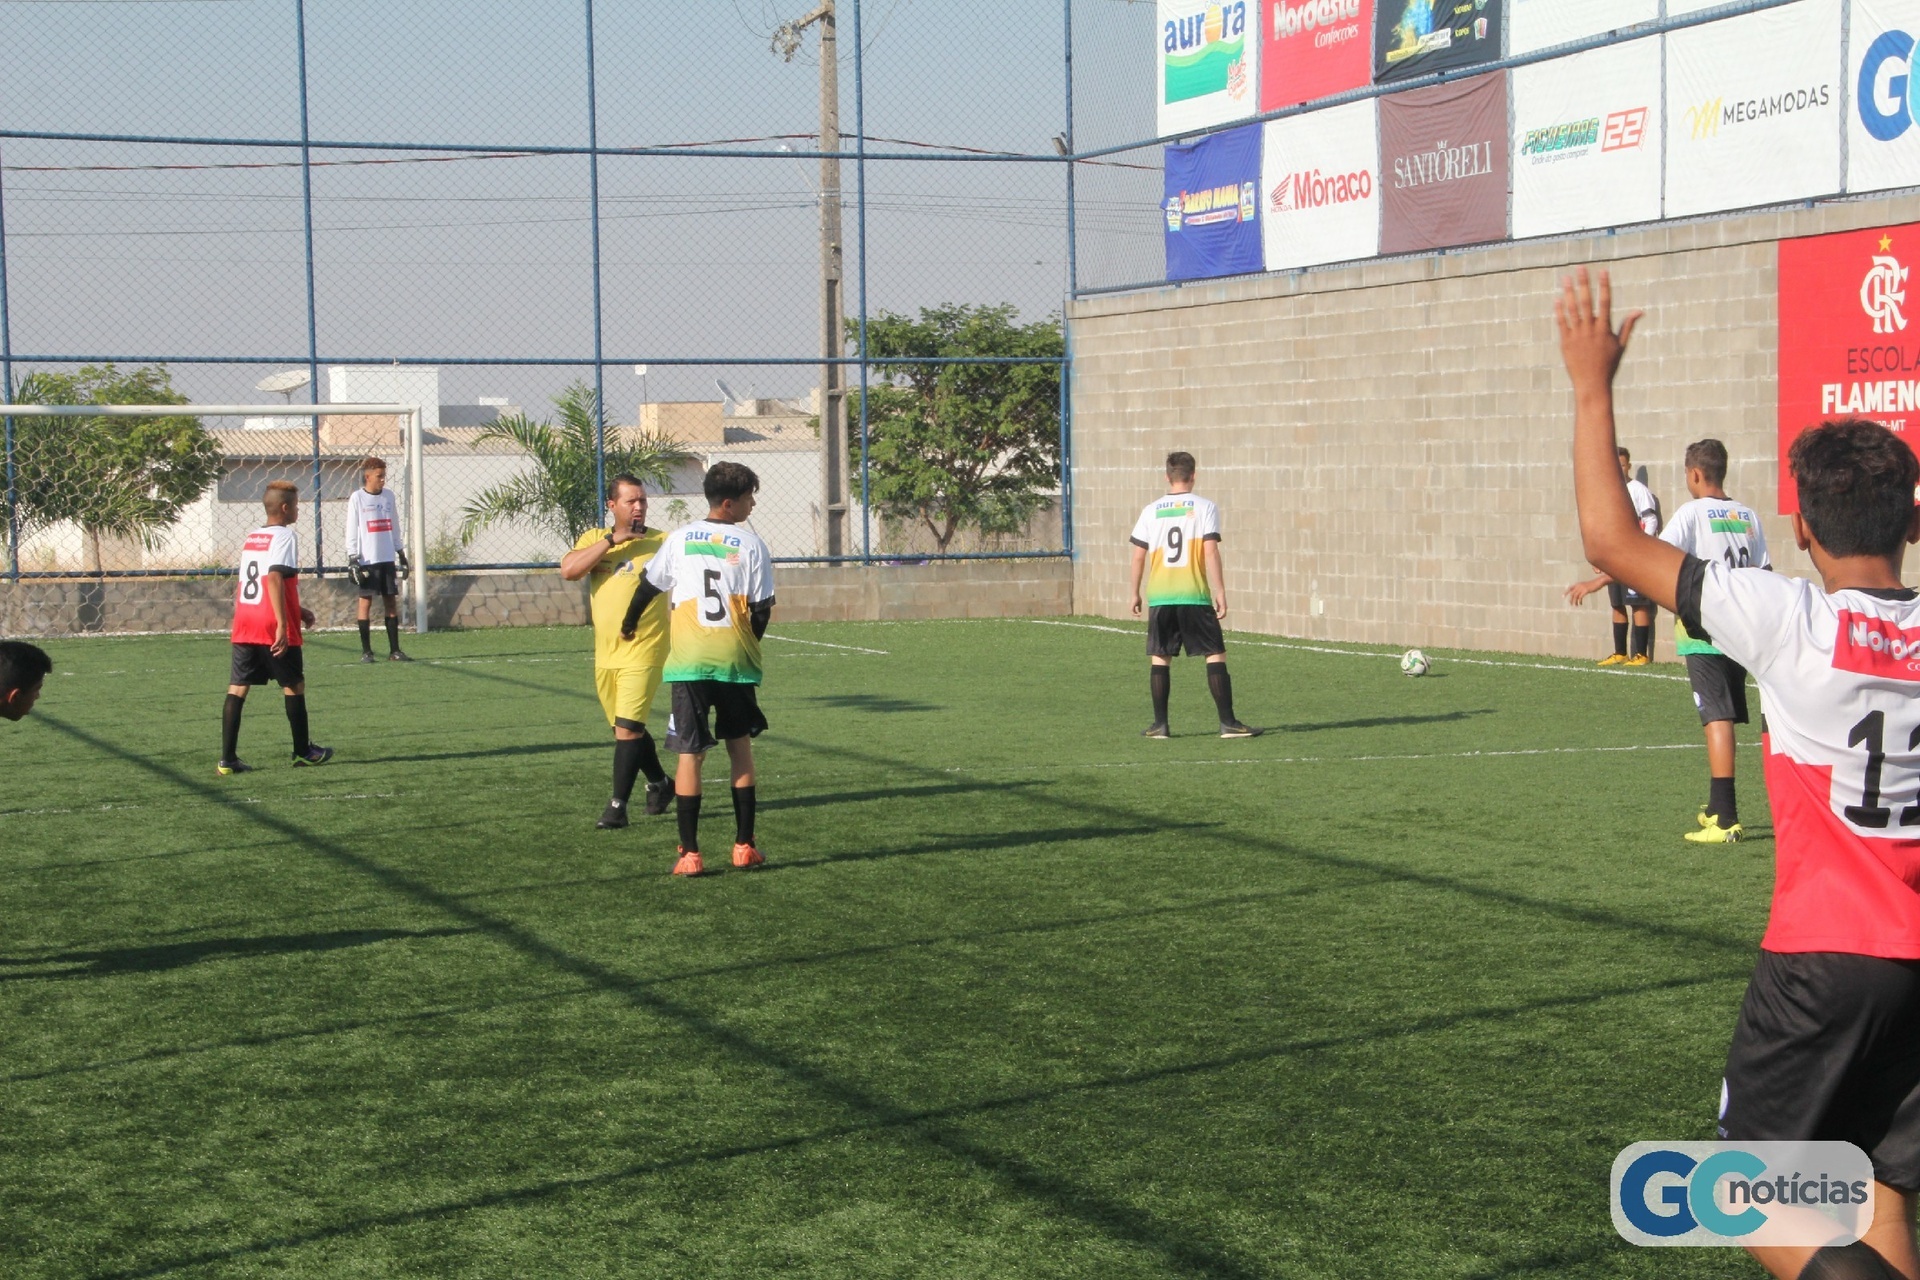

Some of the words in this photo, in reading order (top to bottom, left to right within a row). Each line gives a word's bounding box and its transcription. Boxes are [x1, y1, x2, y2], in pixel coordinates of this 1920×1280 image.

[1164, 0, 1246, 53] aurora
[1314, 23, 1359, 49] Confecções
[1857, 29, 1920, 141] G
[1723, 85, 1829, 125] MEGAMODAS
[1603, 111, 1645, 150] 22
[1294, 168, 1371, 210] Mônaco
[1156, 500, 1194, 510] aurora
[1707, 508, 1750, 520] aurora
[685, 531, 741, 546] aurora
[1167, 526, 1183, 563] 9
[243, 560, 259, 599] 8
[703, 569, 726, 621] 5
